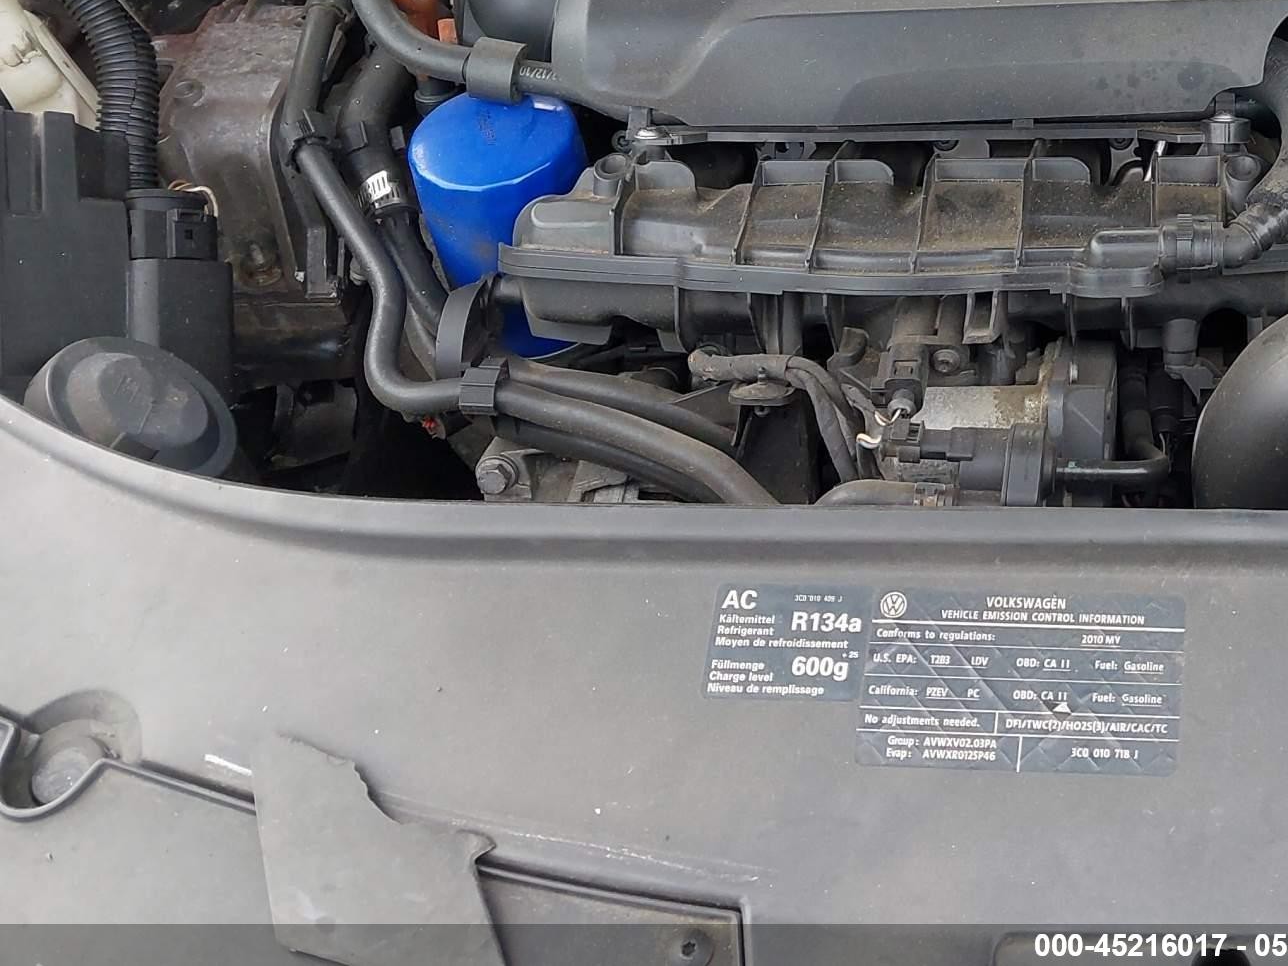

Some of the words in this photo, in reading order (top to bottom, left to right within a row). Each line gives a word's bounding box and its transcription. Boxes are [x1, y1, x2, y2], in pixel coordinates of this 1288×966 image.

[721, 590, 758, 610] AC
[986, 596, 1066, 610] VOLKSWAGEN
[719, 614, 776, 625] Kältemittel
[791, 611, 862, 633] R134a
[941, 609, 979, 620] VEHICLE
[982, 610, 1027, 621] EMISSION
[1032, 612, 1075, 623] CONTROL
[1079, 613, 1145, 625] INFORMATION
[717, 625, 775, 637] Refrigerant
[876, 628, 921, 639] Conforms
[925, 629, 936, 639] to
[939, 631, 996, 642] regulations:
[714, 637, 750, 648] Moyen
[753, 638, 766, 647] de
[768, 638, 849, 649] refroidissement
[1081, 634, 1103, 644] 2010
[711, 659, 765, 670] Füllmenge
[791, 656, 849, 682] 600g
[873, 653, 891, 663] U.S.
[896, 654, 917, 664] EPA:
[971, 656, 989, 666] LDV
[1016, 658, 1040, 668] OBD:
[1044, 658, 1057, 668] CA
[1095, 659, 1118, 670] Fuel:
[1124, 661, 1164, 672] Gasoline
[709, 671, 746, 683] Charge
[749, 672, 774, 682] level
[706, 683, 743, 693] Niveau
[746, 684, 759, 693] de
[762, 685, 825, 697] remplissage
[868, 685, 919, 696] California:
[926, 687, 949, 697] PZEV
[967, 688, 980, 698] PC
[1013, 690, 1037, 700] OBD:
[1041, 690, 1054, 700] CA
[1092, 693, 1116, 703] Fuel:
[1121, 694, 1162, 704] Gasoline
[864, 714, 878, 724] No
[881, 715, 940, 726] adjustments
[943, 717, 981, 727] needed.
[1093, 748, 1110, 758] 010
